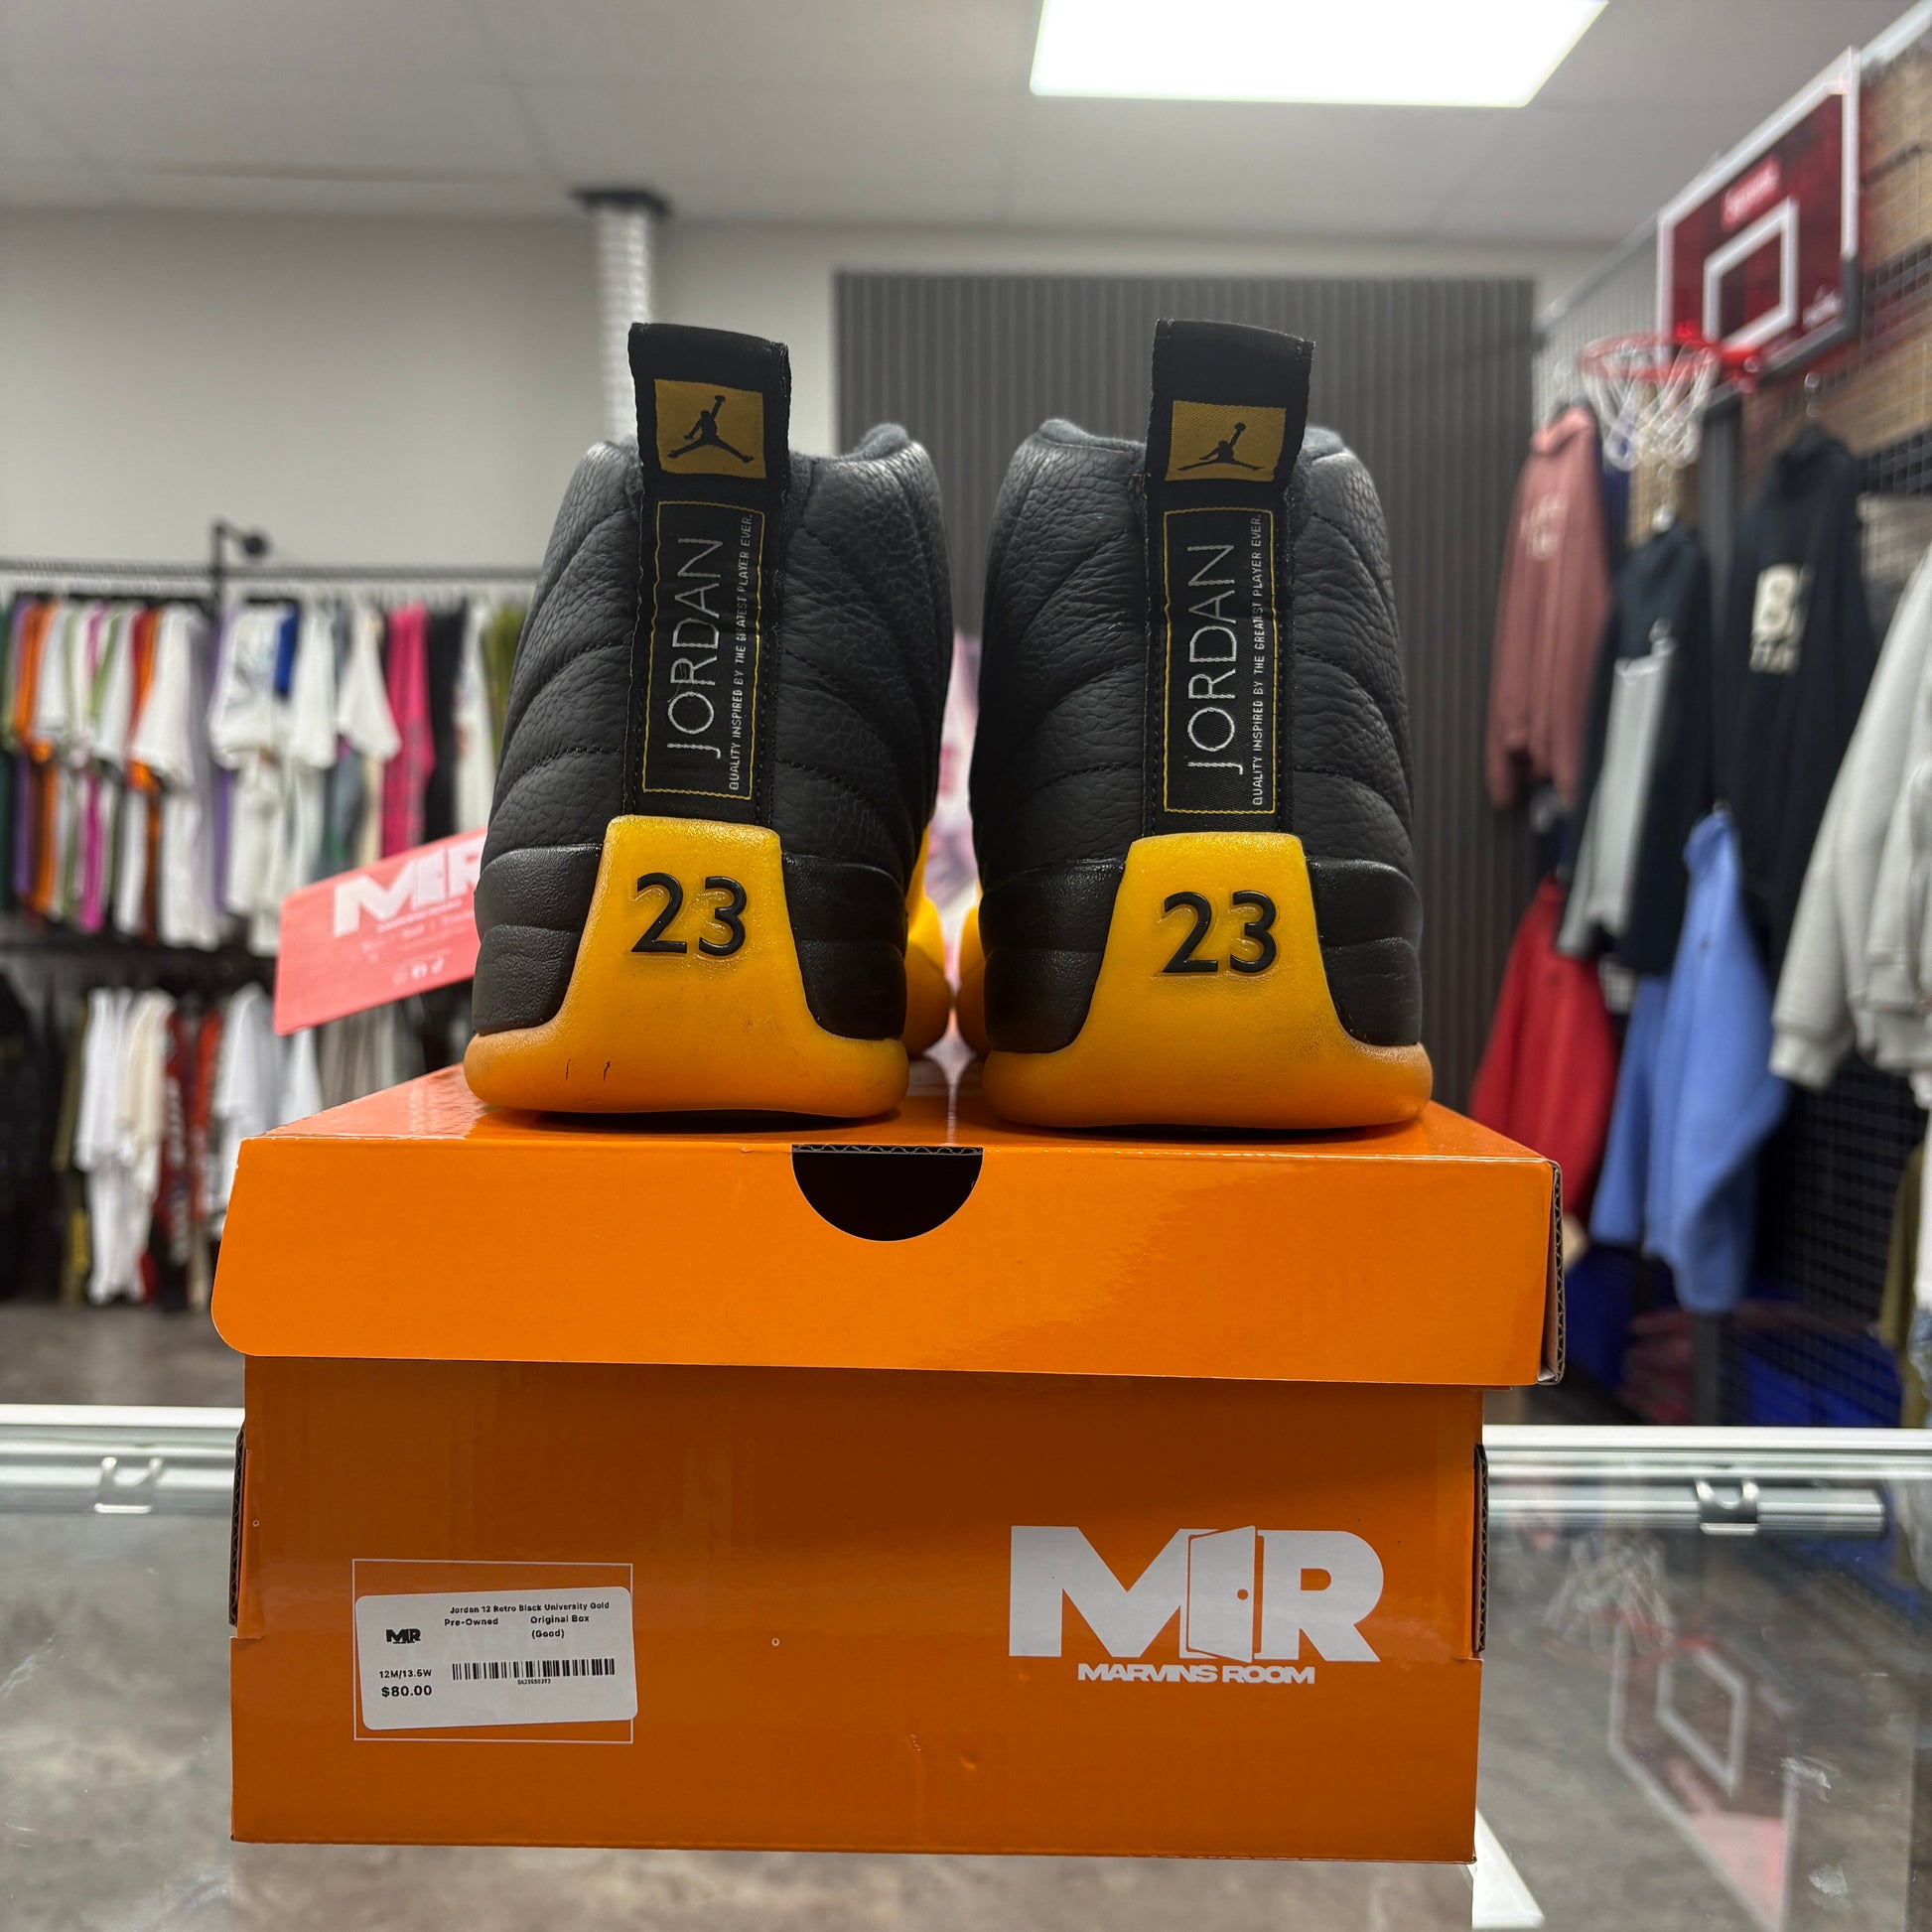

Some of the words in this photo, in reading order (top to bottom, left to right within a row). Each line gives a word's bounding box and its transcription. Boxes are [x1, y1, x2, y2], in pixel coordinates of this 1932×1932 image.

[740, 513, 754, 546] EVER.
[1250, 513, 1262, 546] EVER.
[737, 552, 750, 592] PLAYER
[1251, 552, 1262, 596] PLAYER
[1252, 603, 1265, 649] GREATEST
[667, 539, 723, 759] JORDAN
[735, 645, 747, 664] THE
[1187, 545, 1243, 774] JORDAN
[1253, 655, 1264, 674] THE
[734, 670, 744, 685] BY
[1252, 681, 1263, 695] BY
[732, 689, 743, 738] INSPIRED
[1252, 701, 1263, 752] INSPIRED
[729, 743, 741, 790] QUALITY
[1252, 756, 1263, 805] QUALITY
[631, 872, 747, 955] 23
[1162, 890, 1277, 974] 23
[492, 1604, 517, 1613] Retro
[518, 1603, 542, 1612] Black
[544, 1602, 588, 1612] University
[1009, 1526, 1384, 1663] MR
[385, 1627, 421, 1643] MR
[444, 1617, 498, 1626] Pre-Owned
[530, 1614, 569, 1625] Original
[571, 1614, 590, 1623] Box
[531, 1628, 565, 1639] (Good)
[379, 1668, 432, 1680] 12M/13.5W
[1077, 1662, 1218, 1683] MARVINS
[1221, 1664, 1315, 1685] ROOM
[381, 1685, 433, 1698] $80.00
